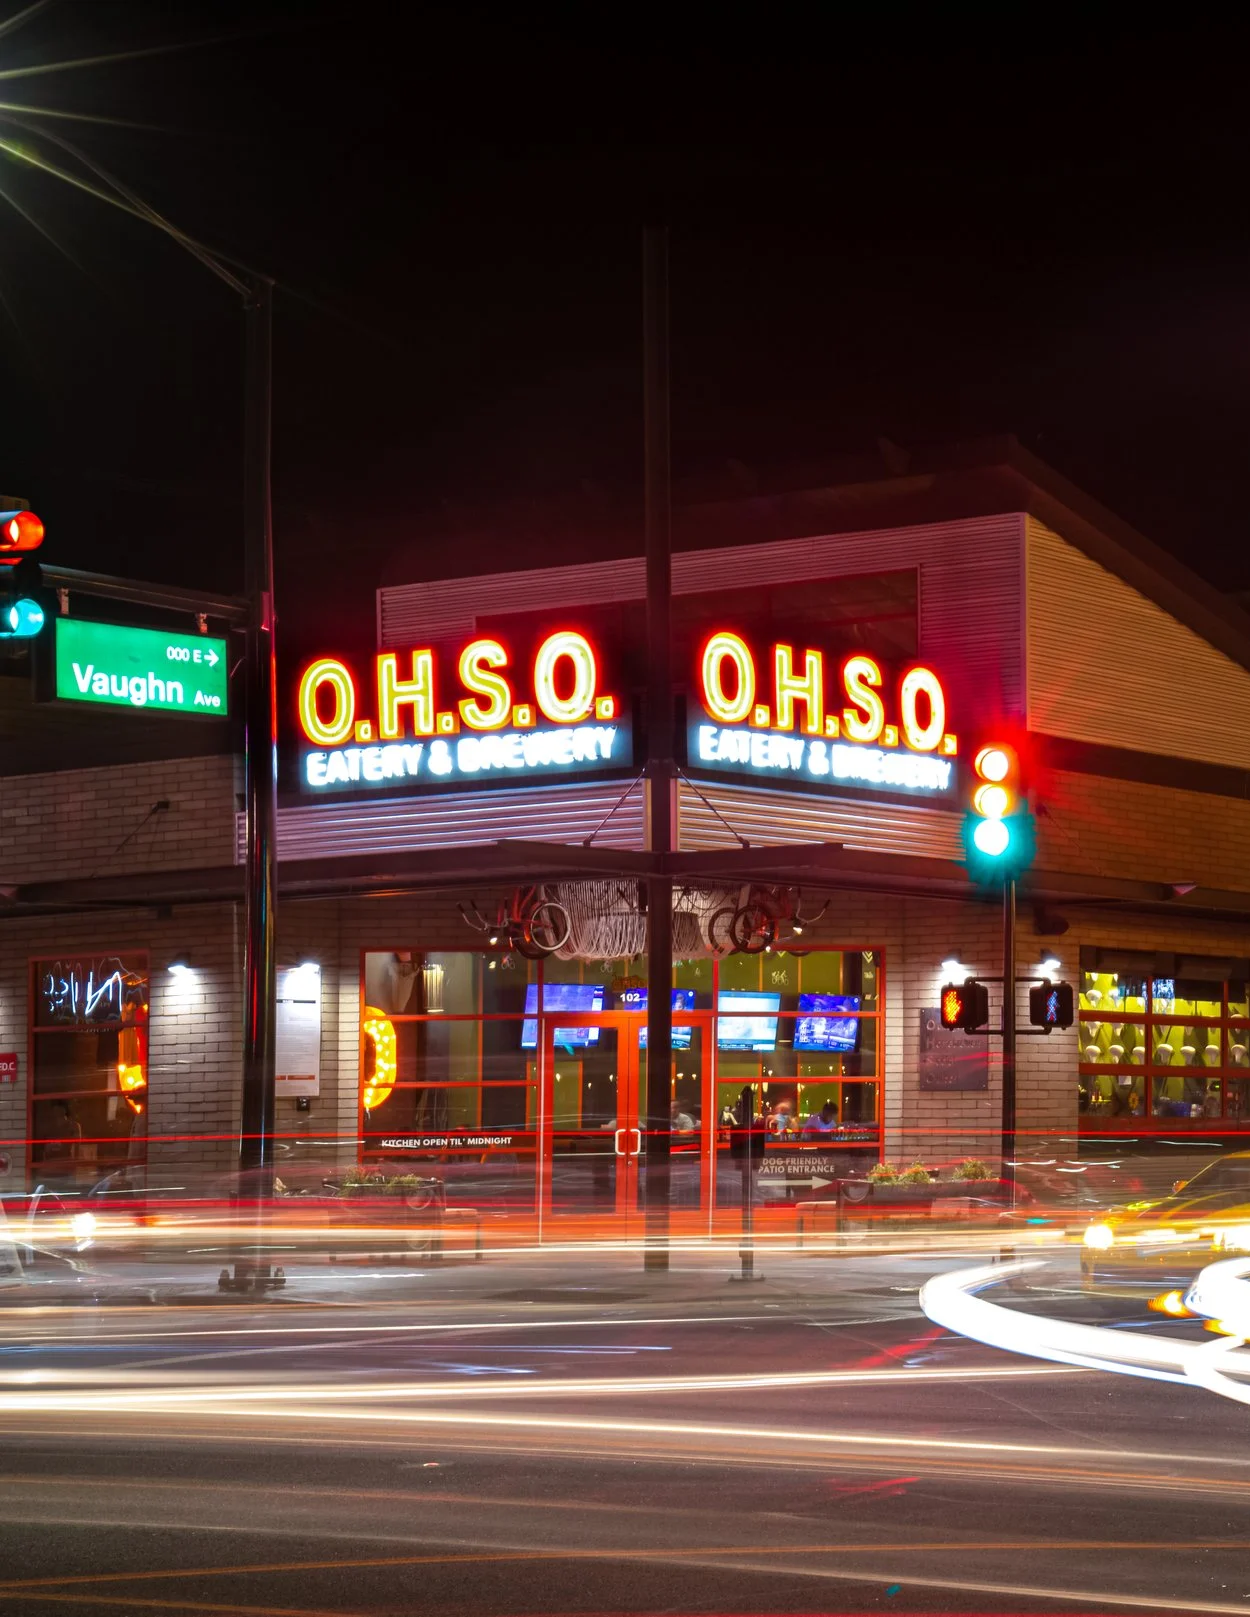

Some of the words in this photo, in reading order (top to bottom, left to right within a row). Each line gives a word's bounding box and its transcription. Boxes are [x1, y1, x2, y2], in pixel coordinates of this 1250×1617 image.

[166, 645, 190, 661] 000
[193, 649, 202, 663] E
[72, 662, 184, 706] Vaughn
[194, 690, 221, 707] Ave
[299, 631, 616, 746] O.H.S.O.
[702, 632, 957, 755] O.H.S.O.
[306, 744, 423, 786] EATERY
[428, 740, 453, 775] &
[457, 725, 617, 773] BREWERY
[699, 725, 804, 770] EATERY
[808, 741, 829, 775] &
[620, 993, 641, 1002] 102
[382, 1139, 420, 1147] KITCHEN
[423, 1138, 447, 1146] OPEN
[449, 1137, 466, 1146] TIL'
[467, 1136, 512, 1145] MIDNIGHT
[758, 1166, 785, 1174] PATIO
[787, 1165, 835, 1173] ENTRANCE
